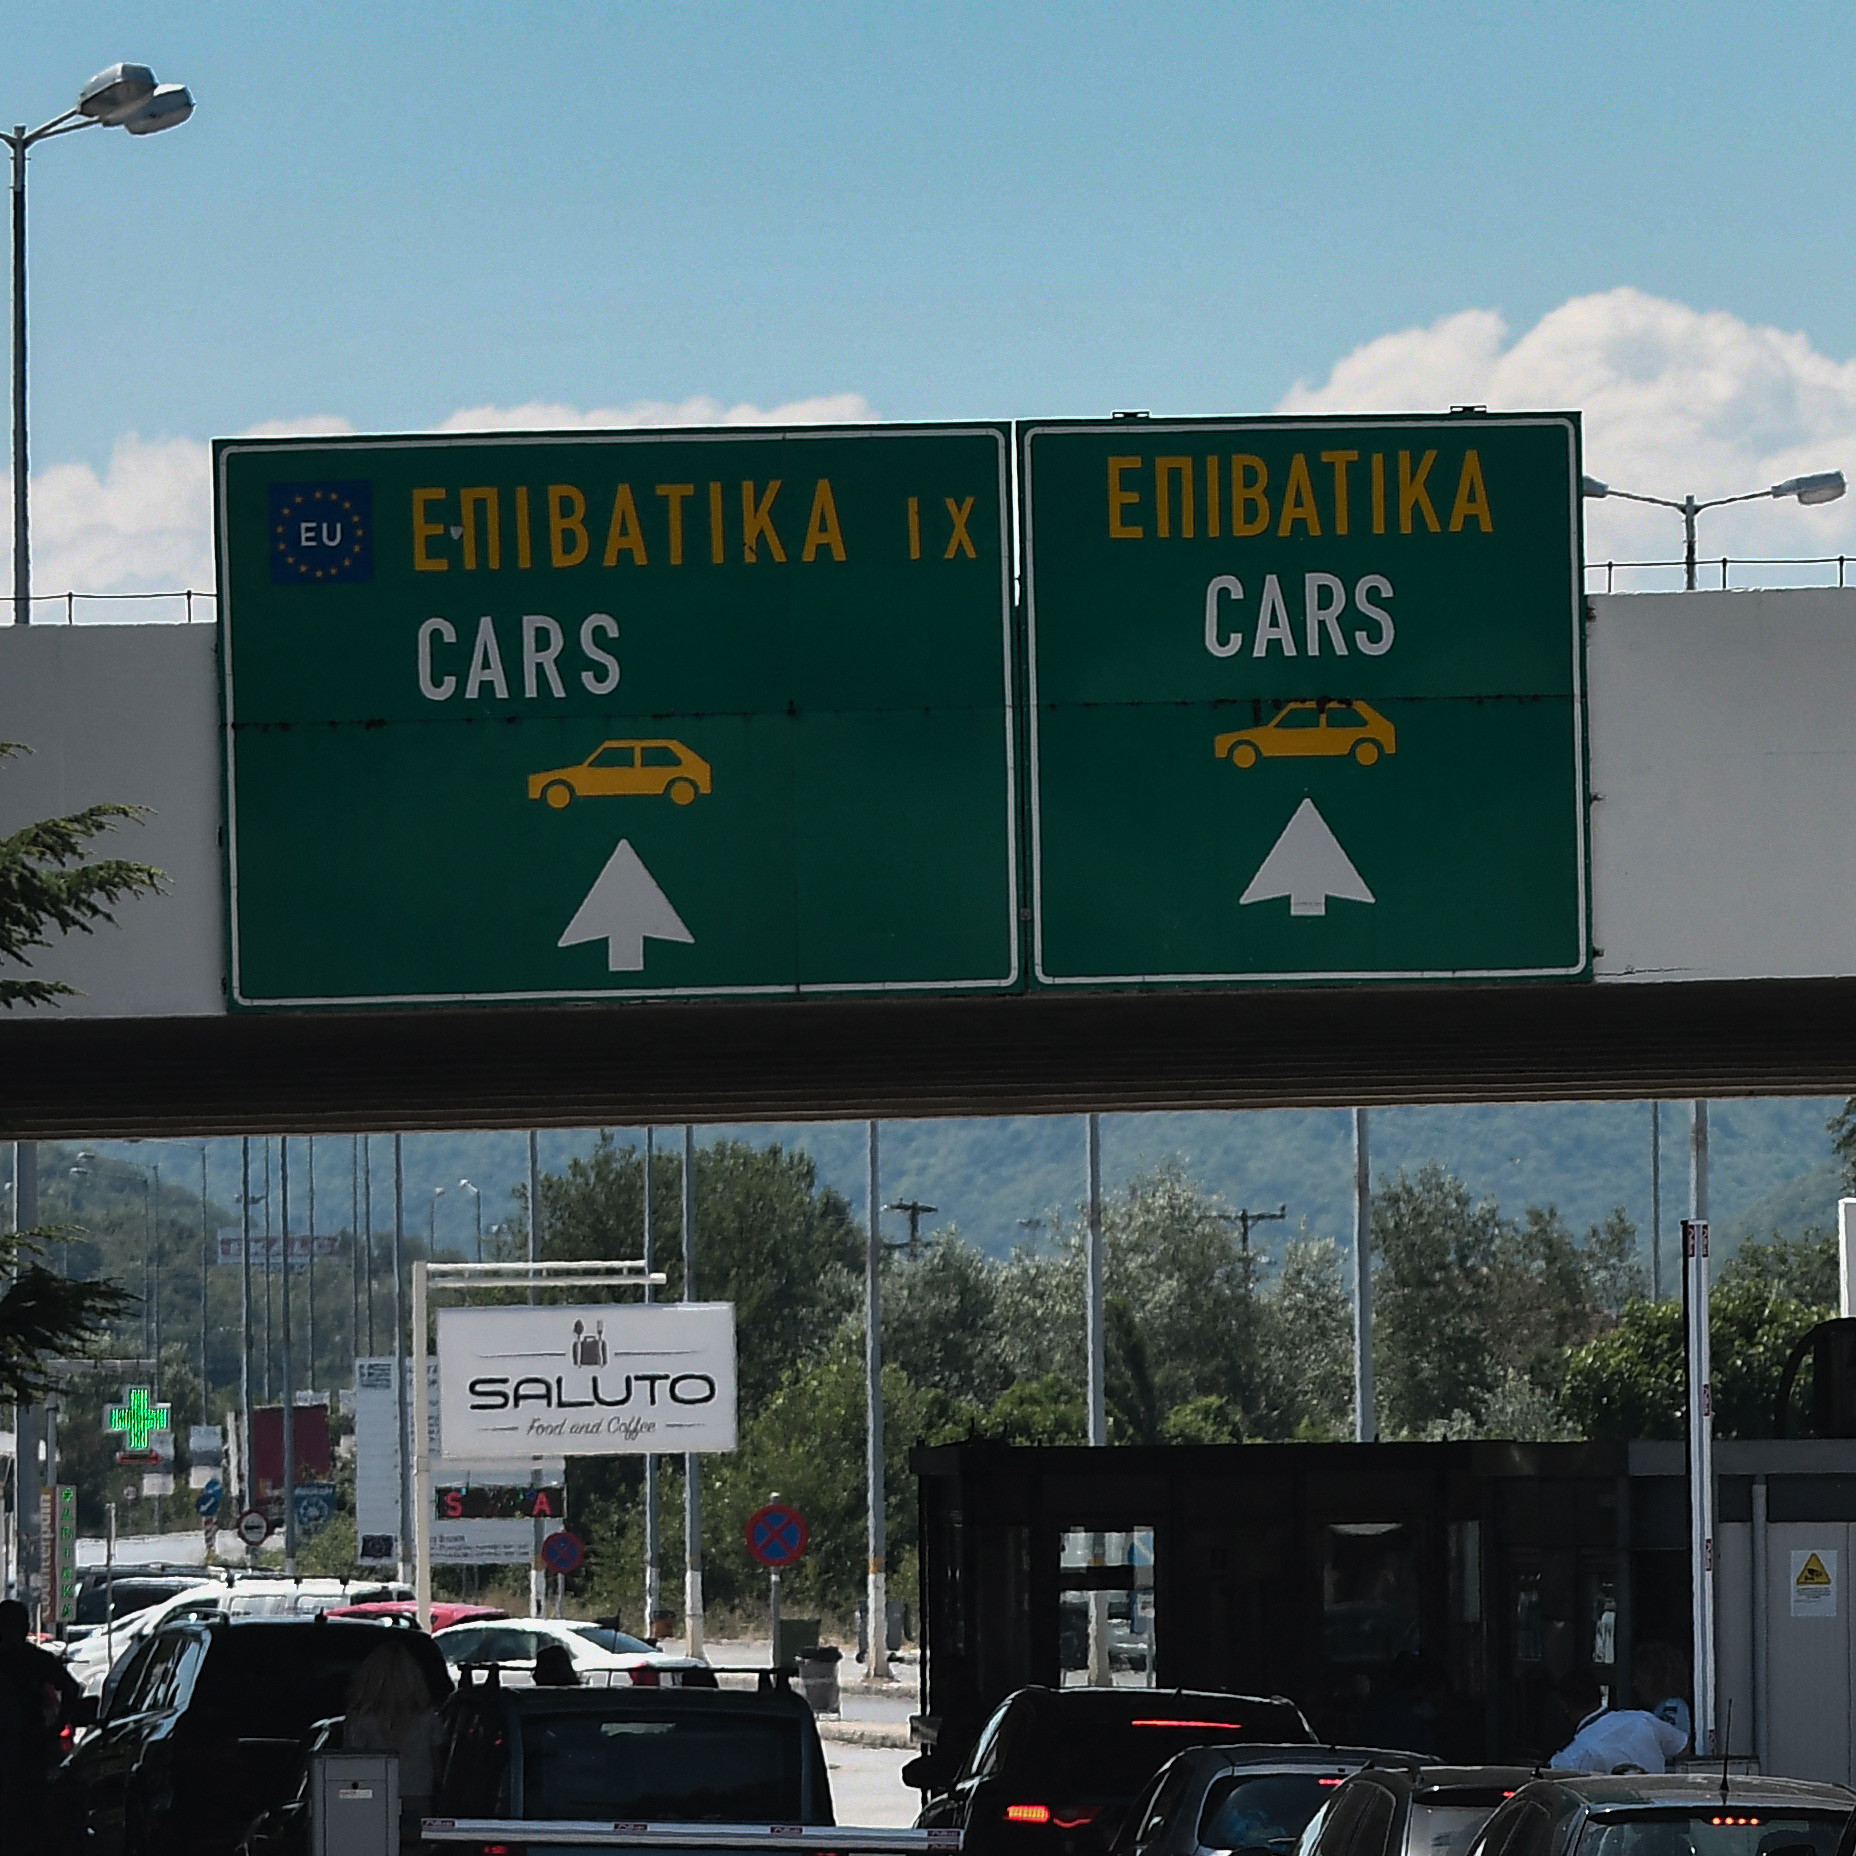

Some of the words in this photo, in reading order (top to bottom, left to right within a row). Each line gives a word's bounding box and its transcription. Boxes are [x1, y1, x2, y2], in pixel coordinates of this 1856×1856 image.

[300, 521, 341, 547] EU
[411, 478, 847, 572] ΕΠΙΒΑΤΙΚΑ
[1106, 449, 1493, 538] ΕΠΙΒΑΤΙΚΑ
[417, 613, 621, 701] CARS
[1204, 572, 1395, 658] CARS
[468, 1373, 717, 1410] SALUTO
[527, 1417, 566, 1436] Food
[569, 1418, 603, 1435] and
[607, 1416, 657, 1441] Coffee
